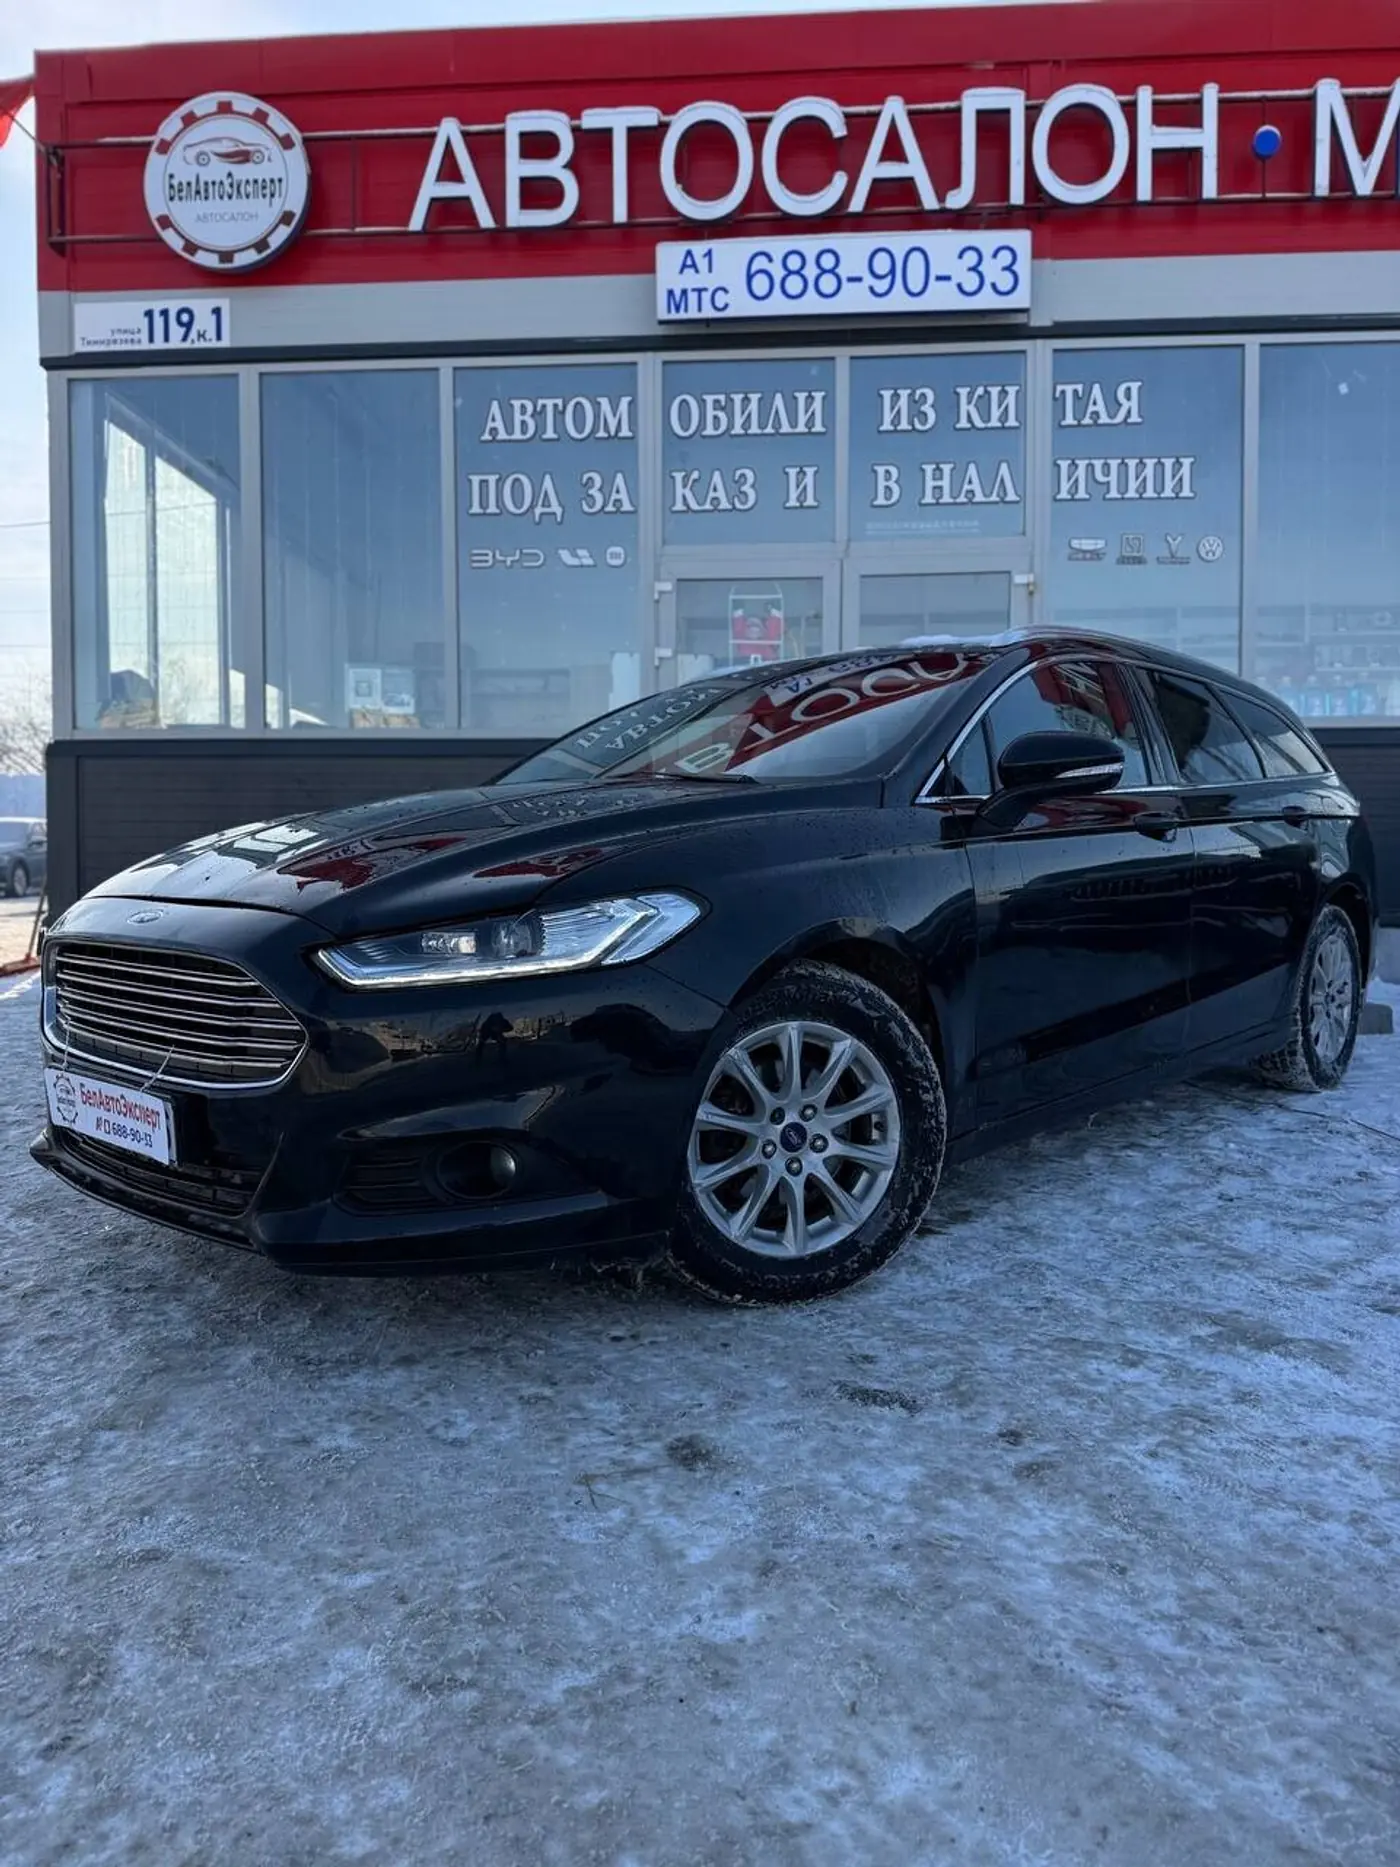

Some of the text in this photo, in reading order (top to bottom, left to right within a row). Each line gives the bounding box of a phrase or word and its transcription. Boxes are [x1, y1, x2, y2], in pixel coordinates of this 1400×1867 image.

[408, 83, 1219, 232] АВТОСАЛОН
[168, 171, 283, 208] БелАвтоЭксперт
[195, 211, 259, 223] АВТОСАЛОН
[746, 245, 1020, 301] 688-90-33
[666, 287, 730, 314] МТС
[110, 327, 142, 337] улица
[480, 380, 1144, 442] АВТОМ ОБИЛИ ИЗ КИ ТАЯ
[467, 456, 1197, 524] ПОД ЗА КАЗ И В НАЛ ИЧИИ
[79, 1083, 161, 1133] БелАвтоЭксперт
